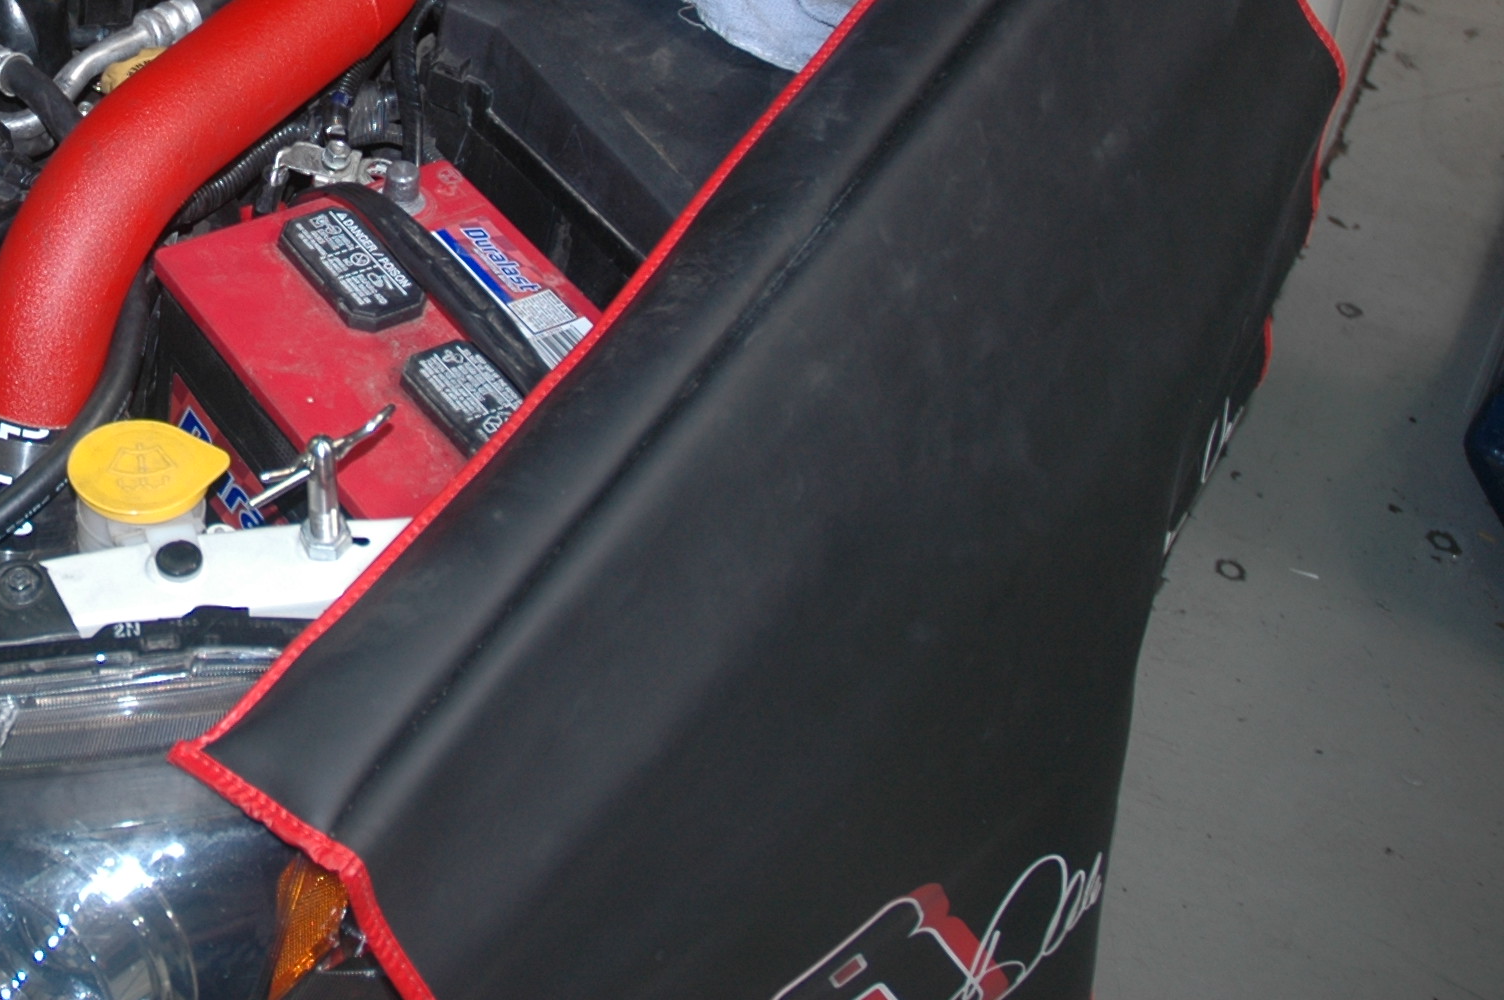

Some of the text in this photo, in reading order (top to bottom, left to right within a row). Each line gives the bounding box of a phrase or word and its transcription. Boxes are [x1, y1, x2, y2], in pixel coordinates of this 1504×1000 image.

[342, 216, 379, 251] DANGER
[377, 256, 412, 287] POISON
[459, 226, 542, 292] Duralast
